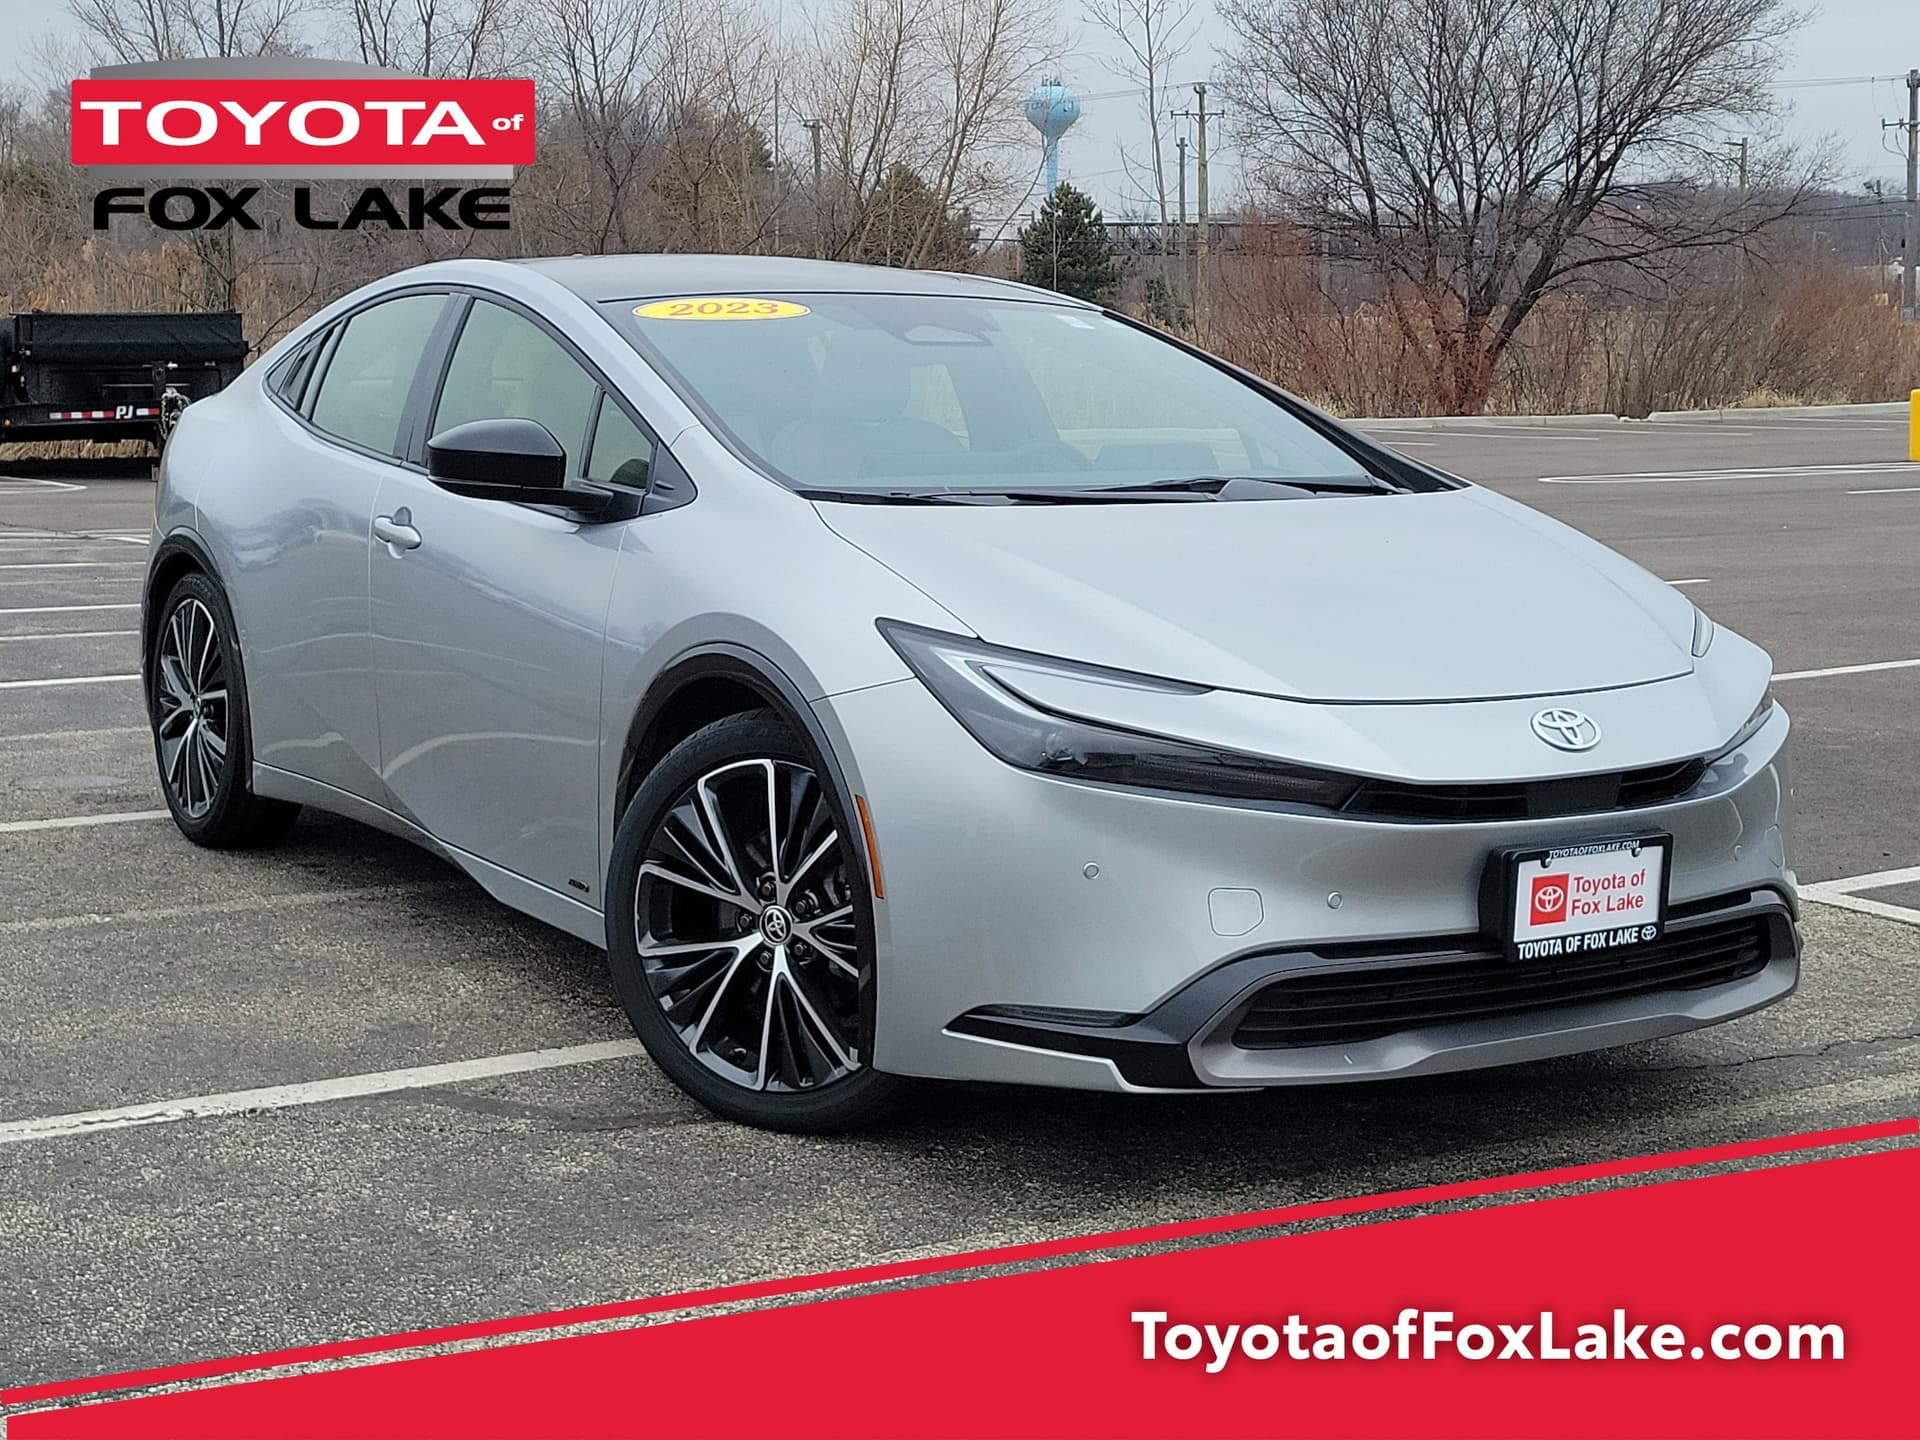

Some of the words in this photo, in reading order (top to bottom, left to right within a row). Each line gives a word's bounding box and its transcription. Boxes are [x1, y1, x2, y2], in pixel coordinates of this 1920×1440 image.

[668, 302, 779, 316] 2023
[115, 405, 134, 419] PJ
[1549, 840, 1640, 859] TOYOTAOFFOXLAKE.COM
[1574, 873, 1626, 896] Toyota
[1631, 868, 1646, 887] of
[1571, 898, 1601, 917] Fox
[1606, 892, 1644, 912] Lake
[1518, 938, 1563, 960] TOYOTA
[1565, 935, 1582, 953] OF
[1583, 931, 1607, 950] FOX
[1609, 927, 1639, 946] LAKE
